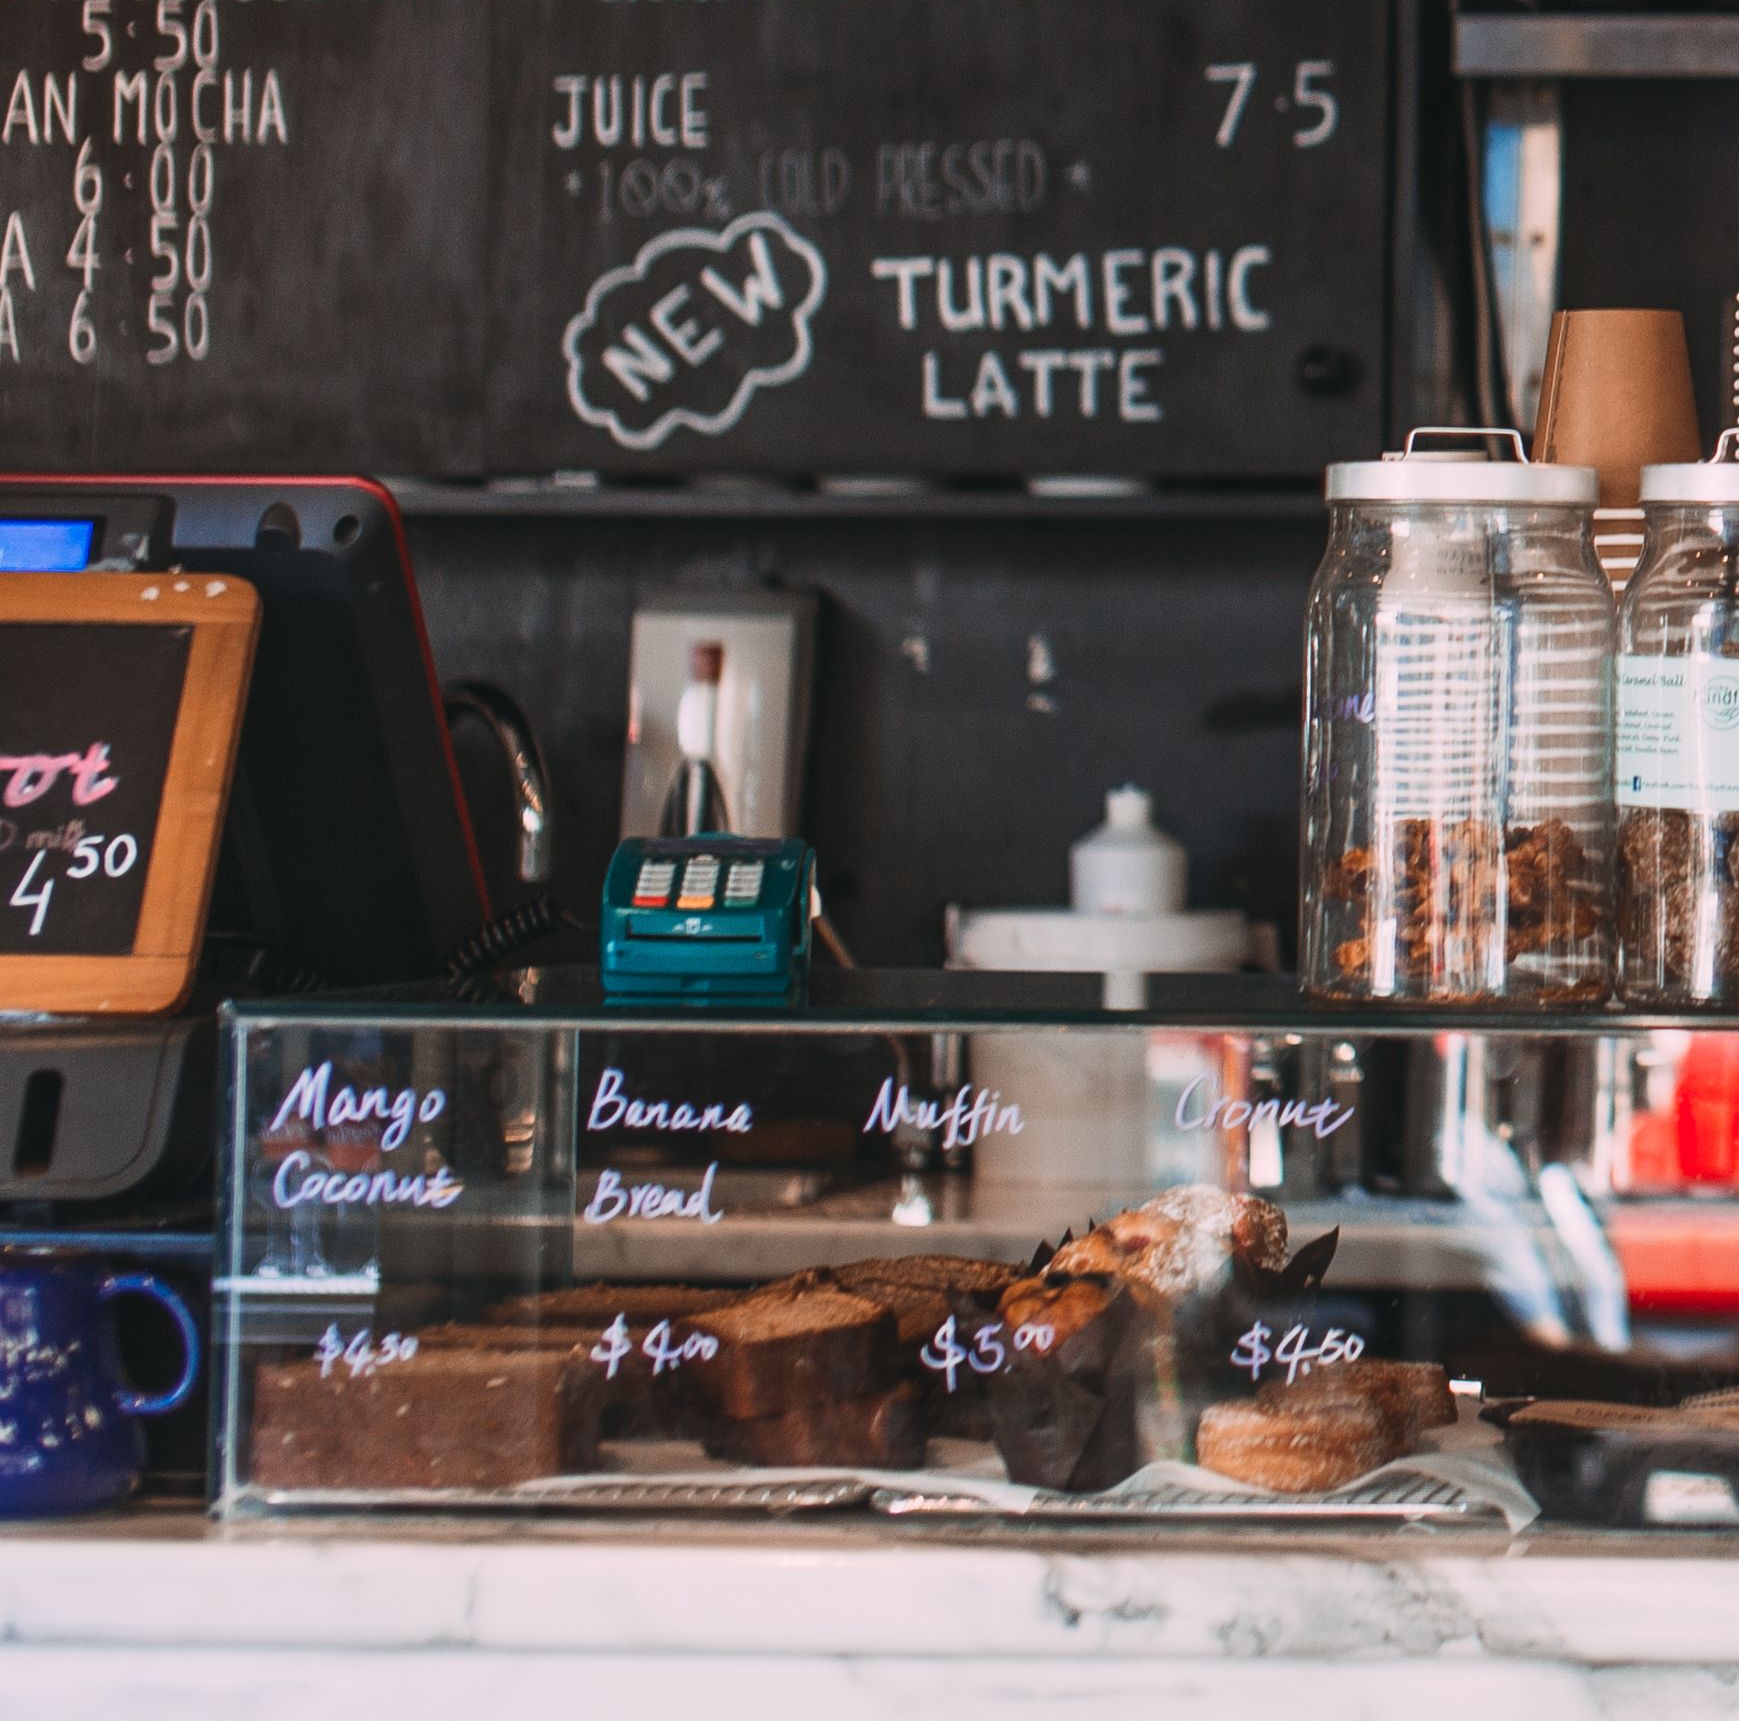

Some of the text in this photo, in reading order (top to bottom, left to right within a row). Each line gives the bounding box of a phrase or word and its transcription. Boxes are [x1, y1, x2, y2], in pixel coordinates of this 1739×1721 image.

[114, 67, 289, 146] MOCHA
[553, 73, 711, 149] JUICE
[602, 230, 784, 403] NEW
[873, 245, 1271, 335] TURMERIC
[922, 351, 1163, 421] LATTE
[271, 1060, 446, 1150] Mango
[587, 1067, 752, 1134] Banana
[863, 1076, 1026, 1149] Muffin
[1175, 1072, 1355, 1137] Cronut
[273, 1151, 461, 1208] Coconut
[584, 1161, 724, 1224] Bread
[1230, 1320, 1365, 1386] $4.50
